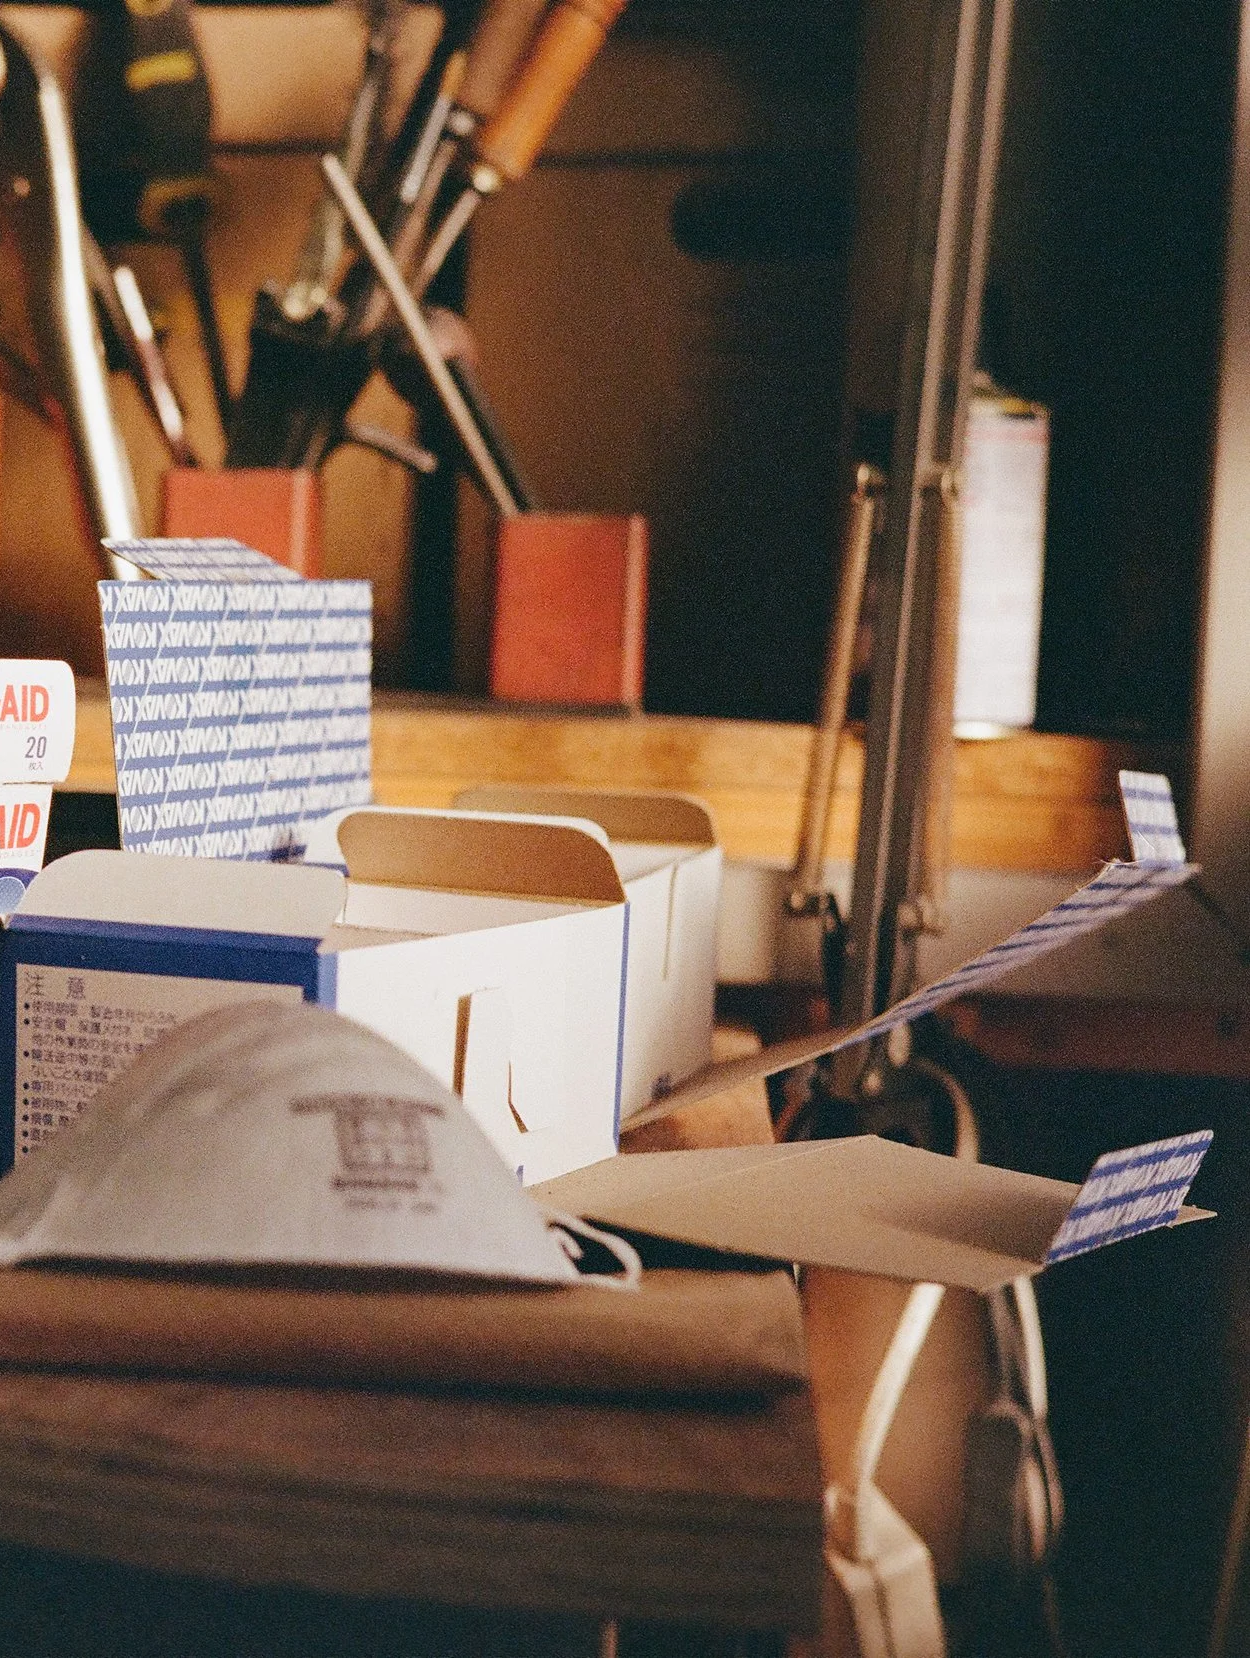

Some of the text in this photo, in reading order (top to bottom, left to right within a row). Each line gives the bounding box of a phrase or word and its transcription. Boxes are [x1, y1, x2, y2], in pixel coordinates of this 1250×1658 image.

[114, 584, 169, 612] KOVAX
[147, 657, 199, 684] KOVAX
[134, 693, 187, 721] KOVAX
[24, 736, 48, 759] 20
[123, 729, 175, 759] KOVAX
[154, 798, 205, 830] KOVAX
